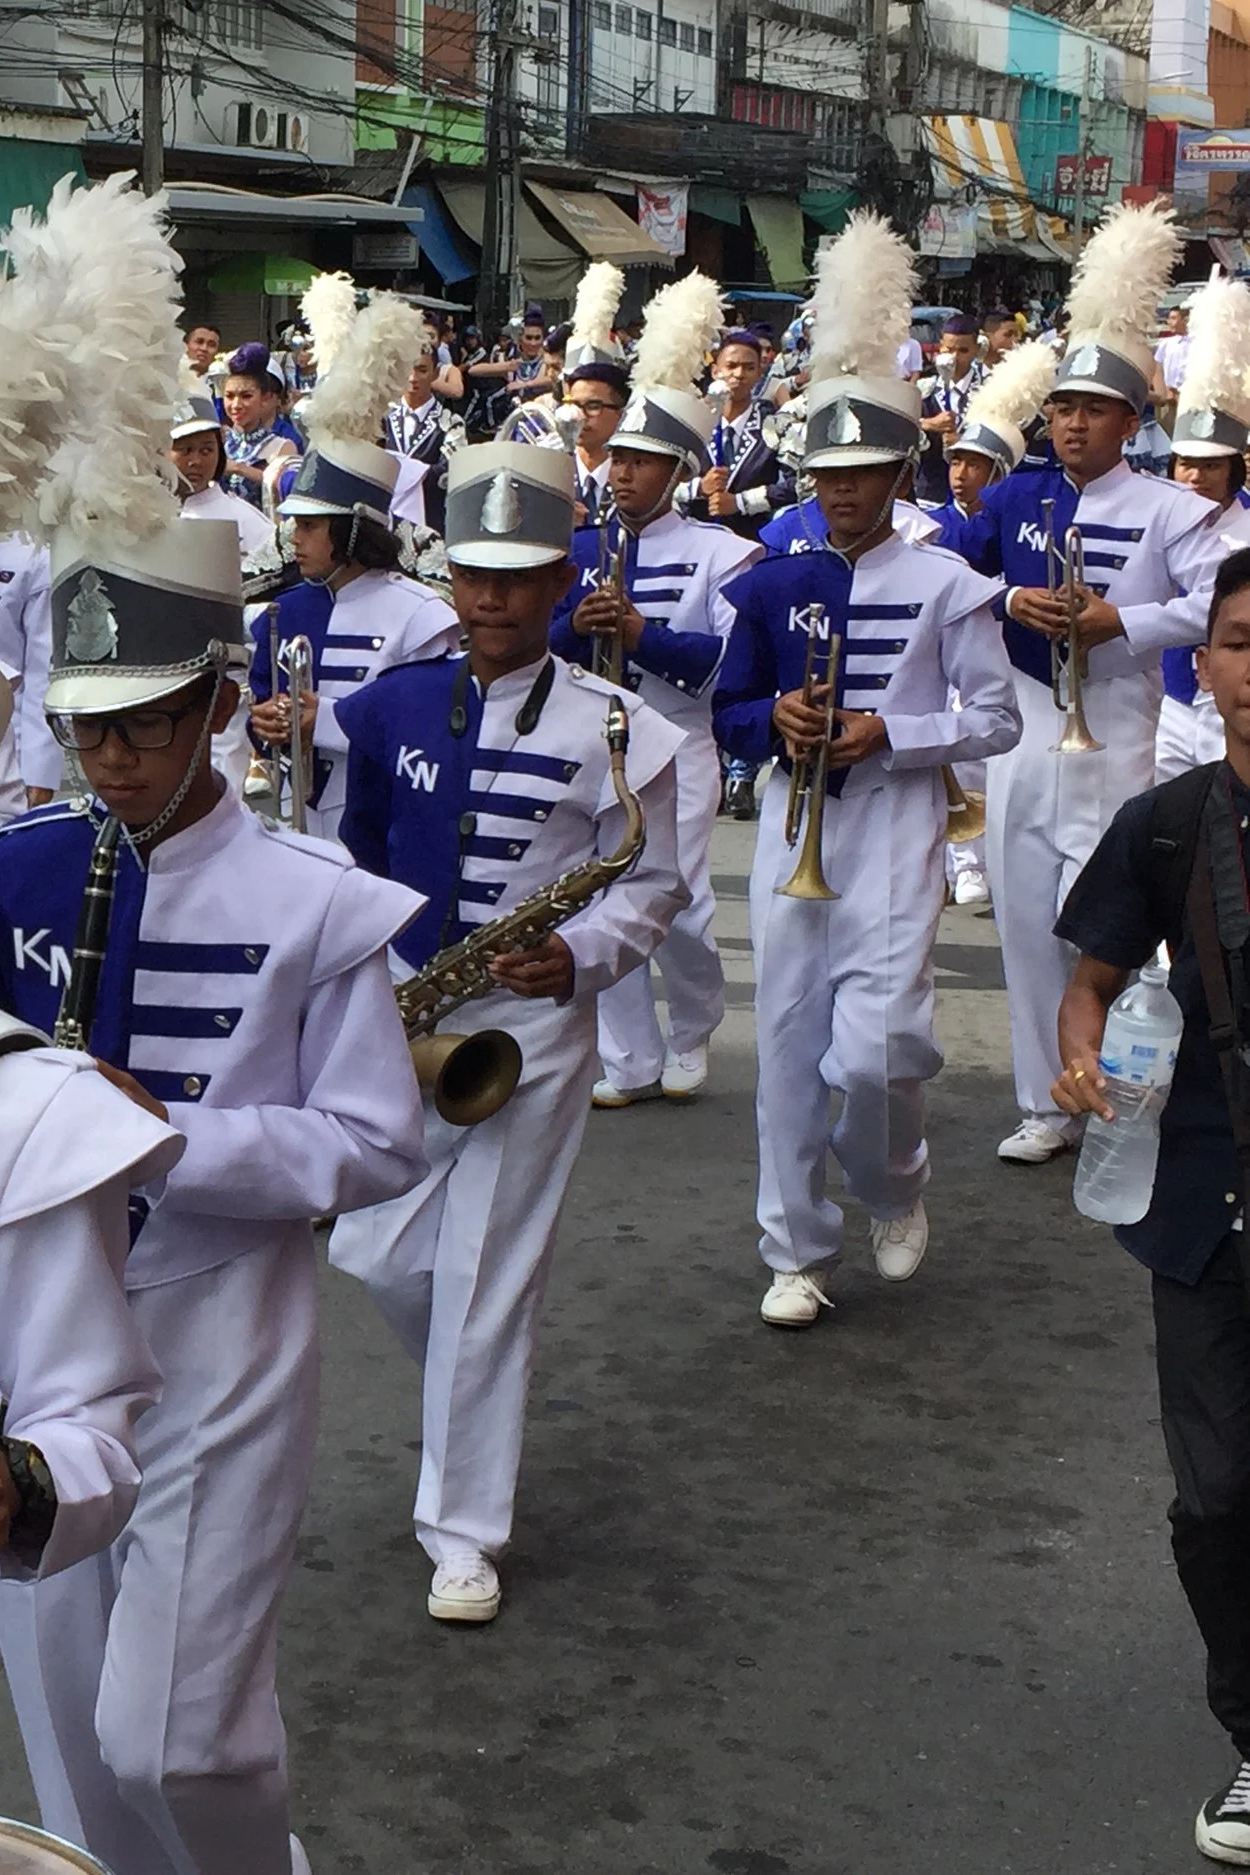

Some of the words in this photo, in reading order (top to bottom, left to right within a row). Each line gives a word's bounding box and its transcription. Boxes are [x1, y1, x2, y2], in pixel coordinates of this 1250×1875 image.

[1017, 521, 1049, 552] KN
[788, 605, 831, 640] KN
[395, 744, 441, 793] KN
[13, 927, 73, 990] KN
